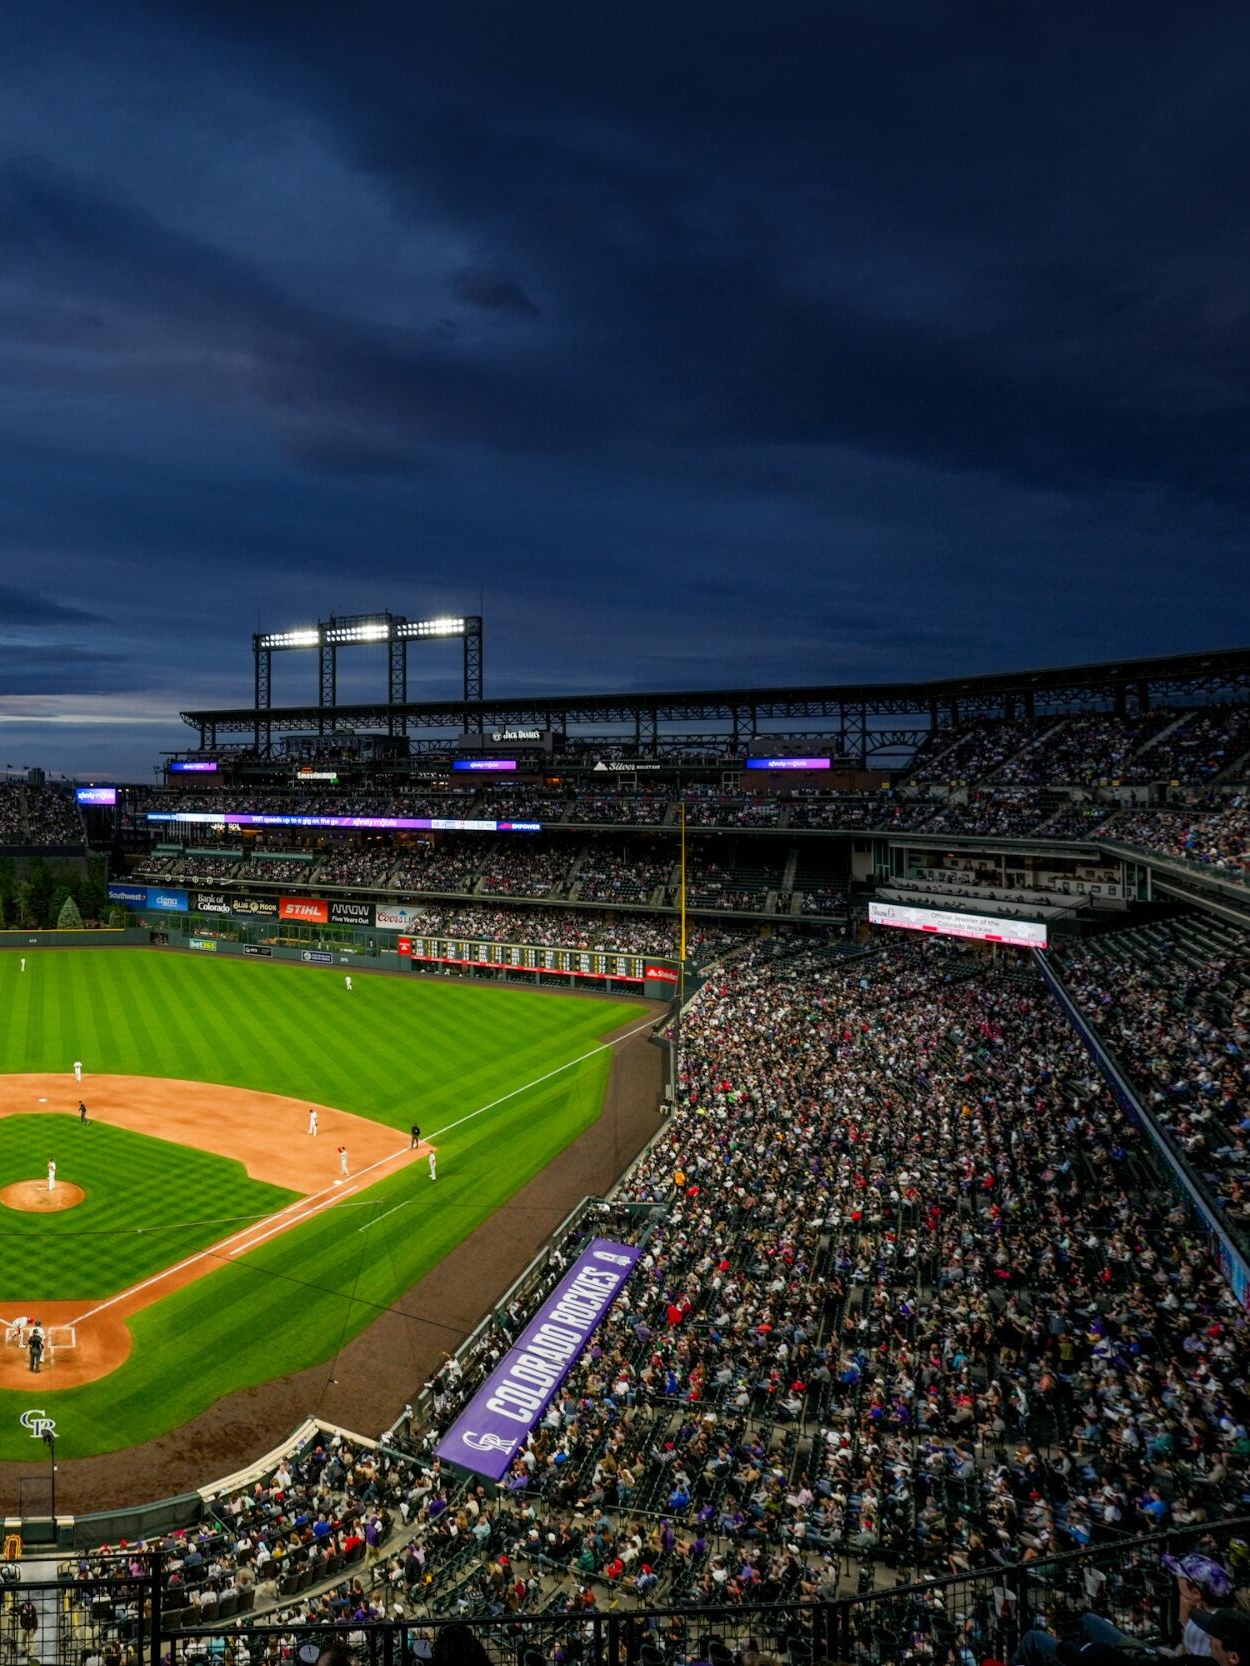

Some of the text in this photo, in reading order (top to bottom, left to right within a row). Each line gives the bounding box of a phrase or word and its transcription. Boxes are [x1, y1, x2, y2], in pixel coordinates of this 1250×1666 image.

[609, 761, 636, 771] Silver
[302, 817, 311, 825] gig
[109, 890, 141, 901] Southwest
[198, 894, 224, 903] Bank of
[198, 903, 230, 912] Colorado
[259, 903, 277, 911] MOON
[286, 904, 322, 916] STIHL
[343, 916, 358, 924] Years
[378, 912, 403, 924] Coors
[931, 912, 953, 921] Official
[989, 919, 1000, 927] the
[486, 1266, 620, 1423] COLORADO ROCKIES
[20, 1409, 59, 1438] CR
